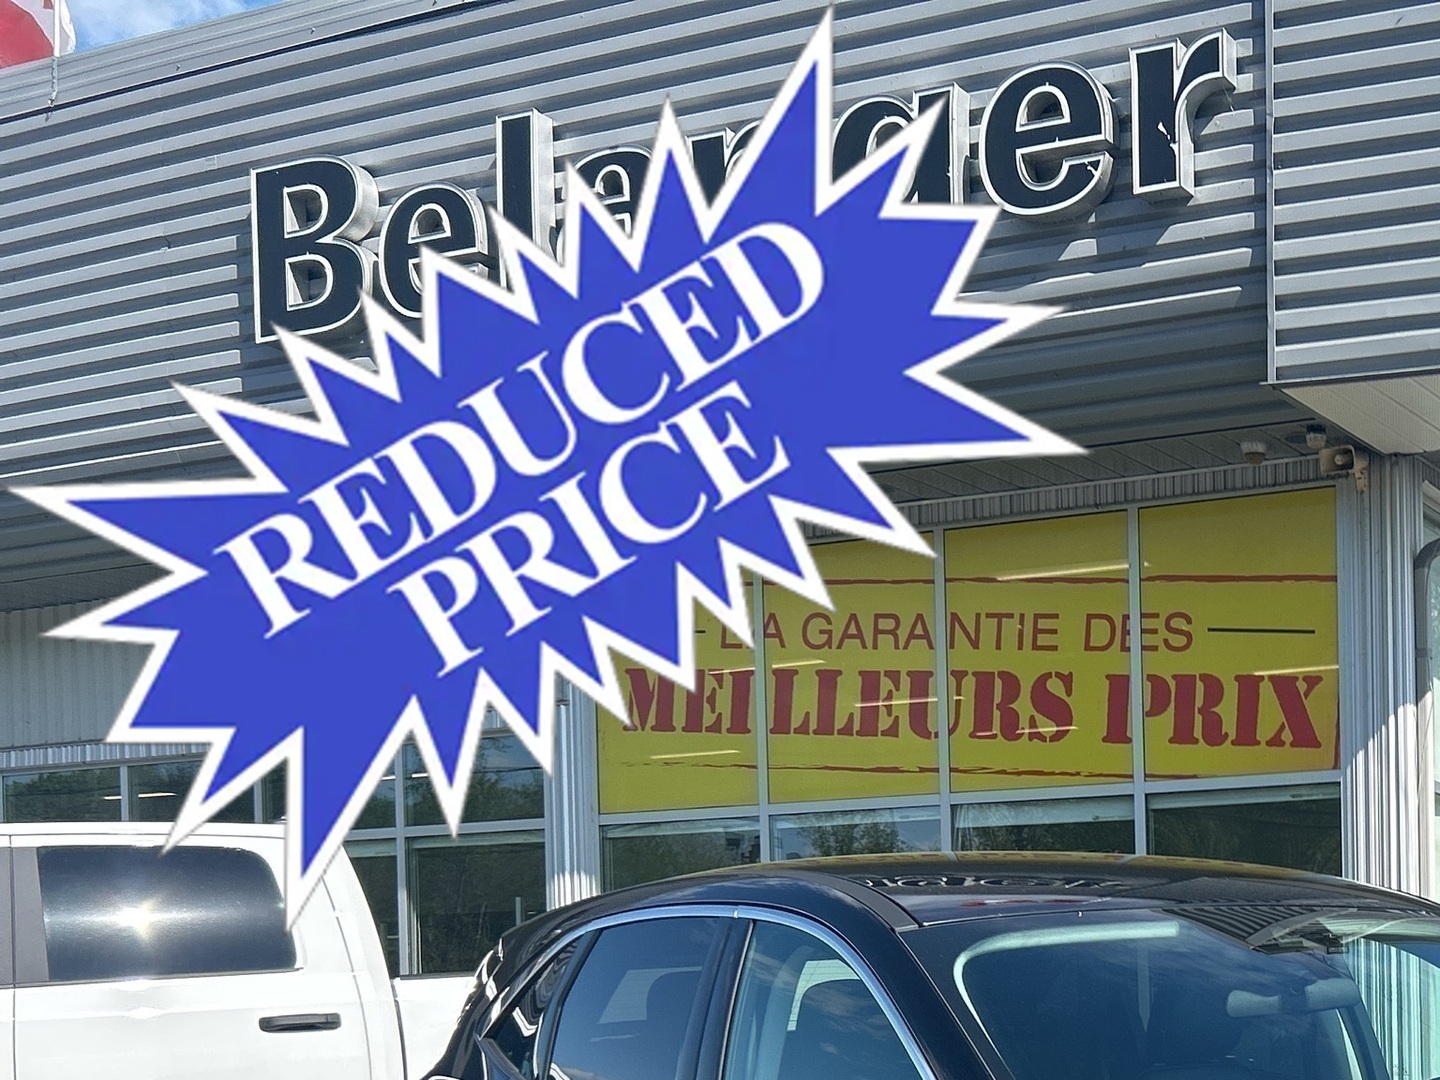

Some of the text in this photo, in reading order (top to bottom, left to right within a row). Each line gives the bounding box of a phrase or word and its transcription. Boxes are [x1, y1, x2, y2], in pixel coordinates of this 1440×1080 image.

[720, 610, 1195, 653] LA GARANTIE DES
[621, 666, 1324, 749] MEILLEURS PRIX
